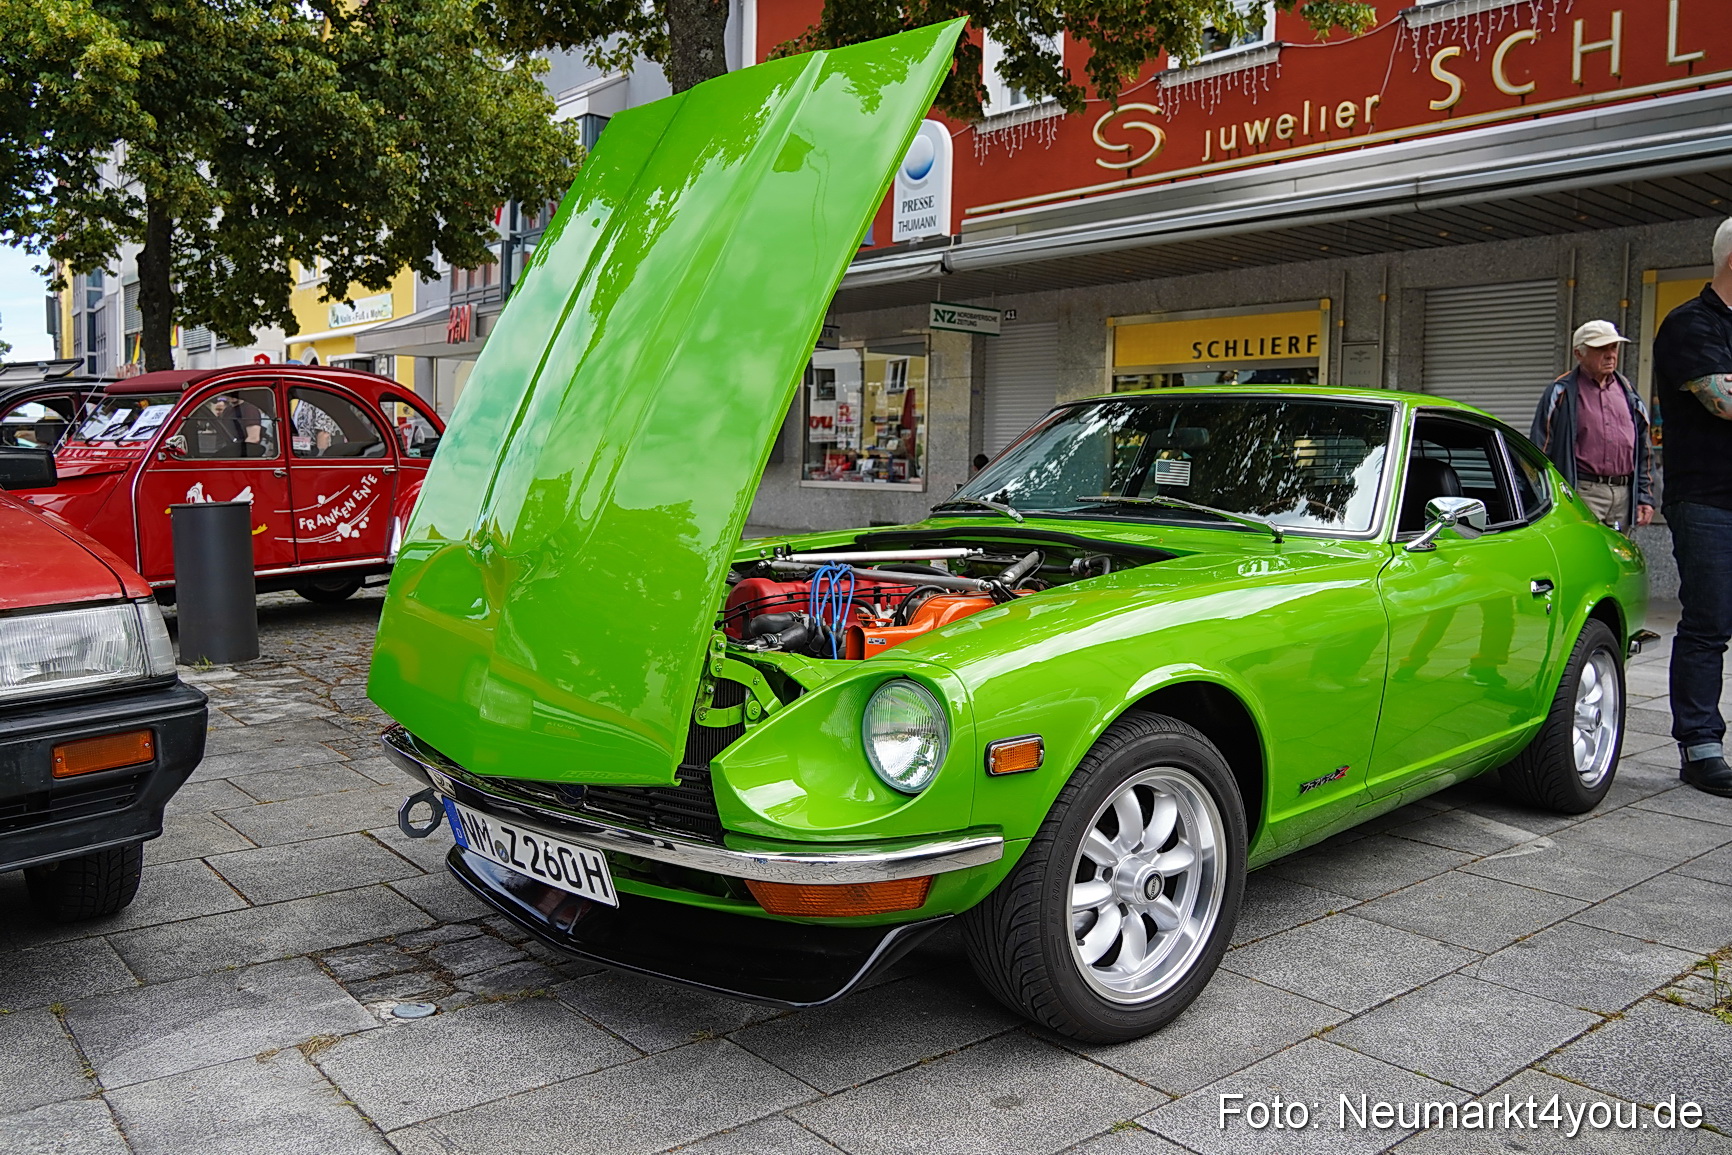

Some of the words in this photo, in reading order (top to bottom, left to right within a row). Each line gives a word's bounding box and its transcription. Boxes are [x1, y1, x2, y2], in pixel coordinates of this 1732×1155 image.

[901, 195, 935, 214] PRESSE
[898, 215, 937, 234] THUMANN
[933, 308, 957, 324] NZ
[957, 311, 998, 323] NORDBAYERISCHE
[957, 318, 978, 327] ZEITUNG
[1005, 310, 1016, 320] 41
[1191, 334, 1319, 360] SCHLIERF
[299, 497, 357, 532] FRANKEN
[352, 473, 378, 501] ENTE
[456, 807, 496, 857] NM
